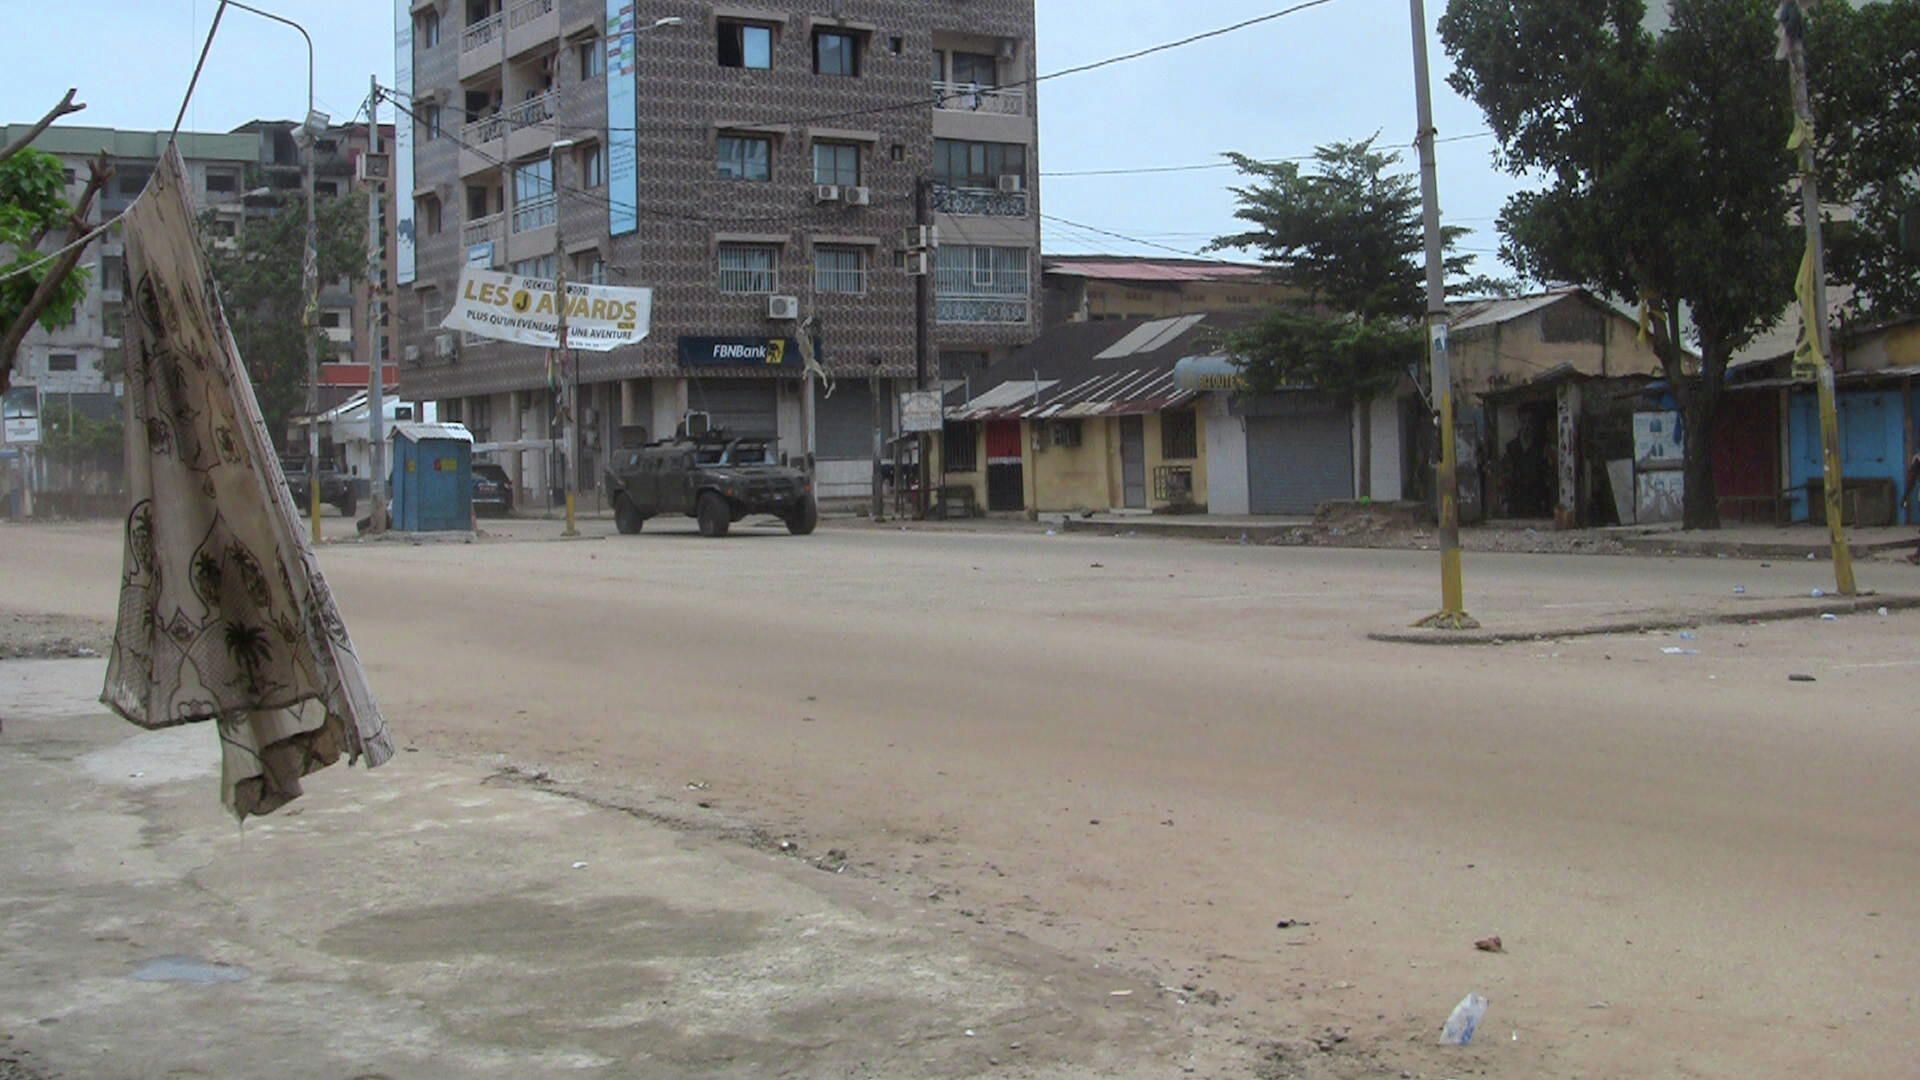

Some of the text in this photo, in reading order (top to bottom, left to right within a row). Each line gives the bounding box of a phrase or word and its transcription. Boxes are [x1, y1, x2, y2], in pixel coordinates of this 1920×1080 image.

[464, 279, 509, 306] LES
[466, 310, 488, 323] PLUS
[571, 328, 589, 339] UNE
[590, 328, 632, 340] AVENTURE
[713, 344, 767, 358] FBNBank
